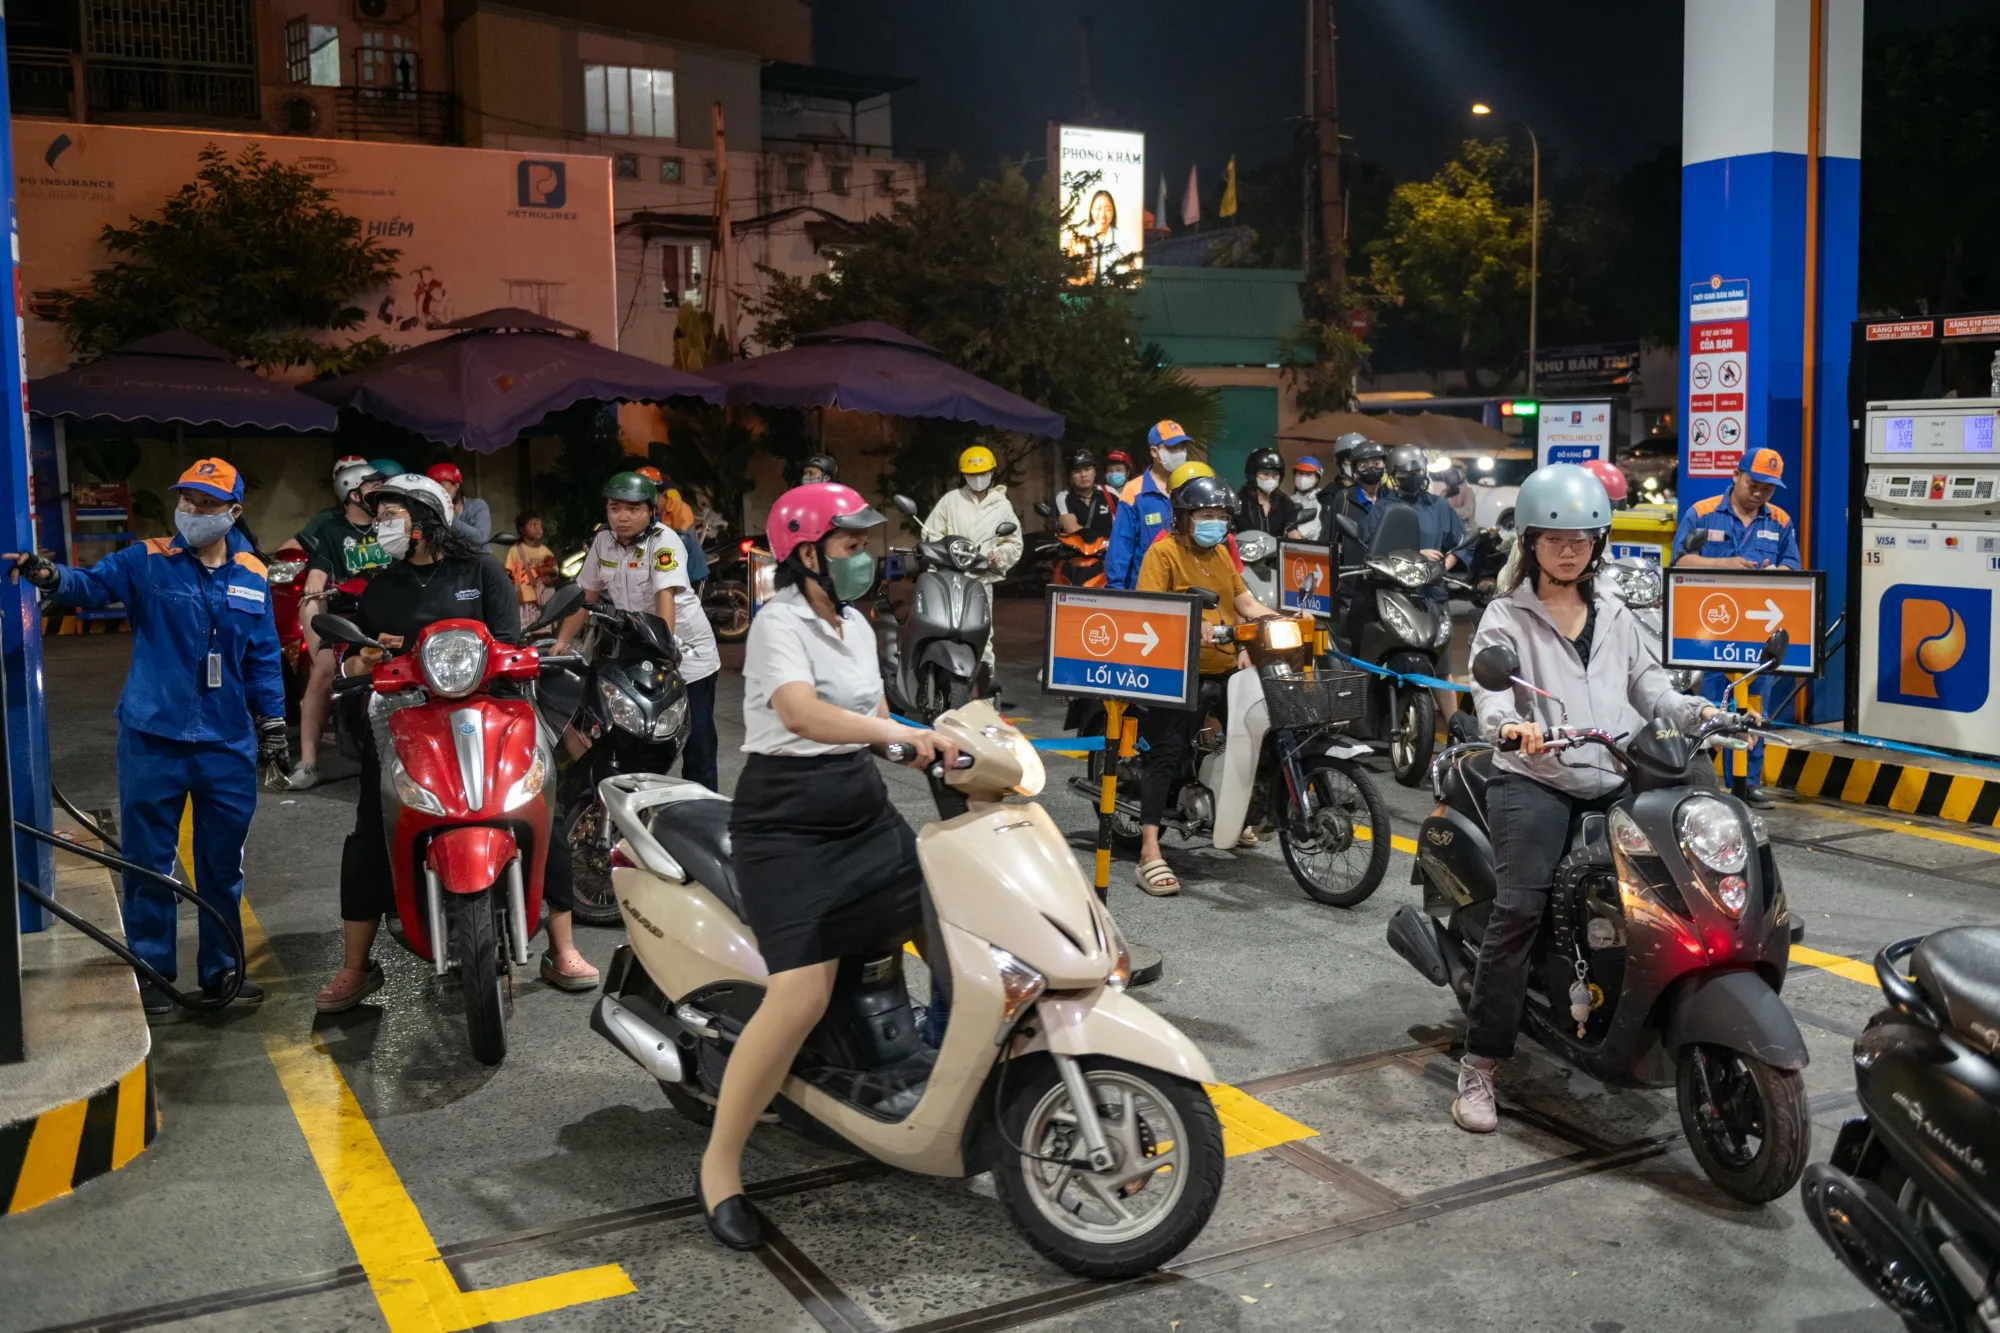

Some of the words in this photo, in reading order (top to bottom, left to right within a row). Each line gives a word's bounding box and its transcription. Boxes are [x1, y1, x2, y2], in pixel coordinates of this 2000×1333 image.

[41, 178, 115, 188] INSURANCE
[1700, 337, 1715, 350] CỦA
[1716, 338, 1733, 351] BẠN
[1535, 361, 1564, 373] KHU
[1547, 433, 1593, 442] PETROLIMEX
[1876, 536, 1896, 545] VISA
[1866, 552, 1881, 563] 15
[1307, 596, 1321, 609] VÀO
[1713, 643, 1740, 661] LỐI
[1086, 664, 1111, 684] LỐI
[1116, 668, 1149, 689] VÀO
[1656, 729, 1680, 739] SYM
[622, 899, 664, 939] LEAD
